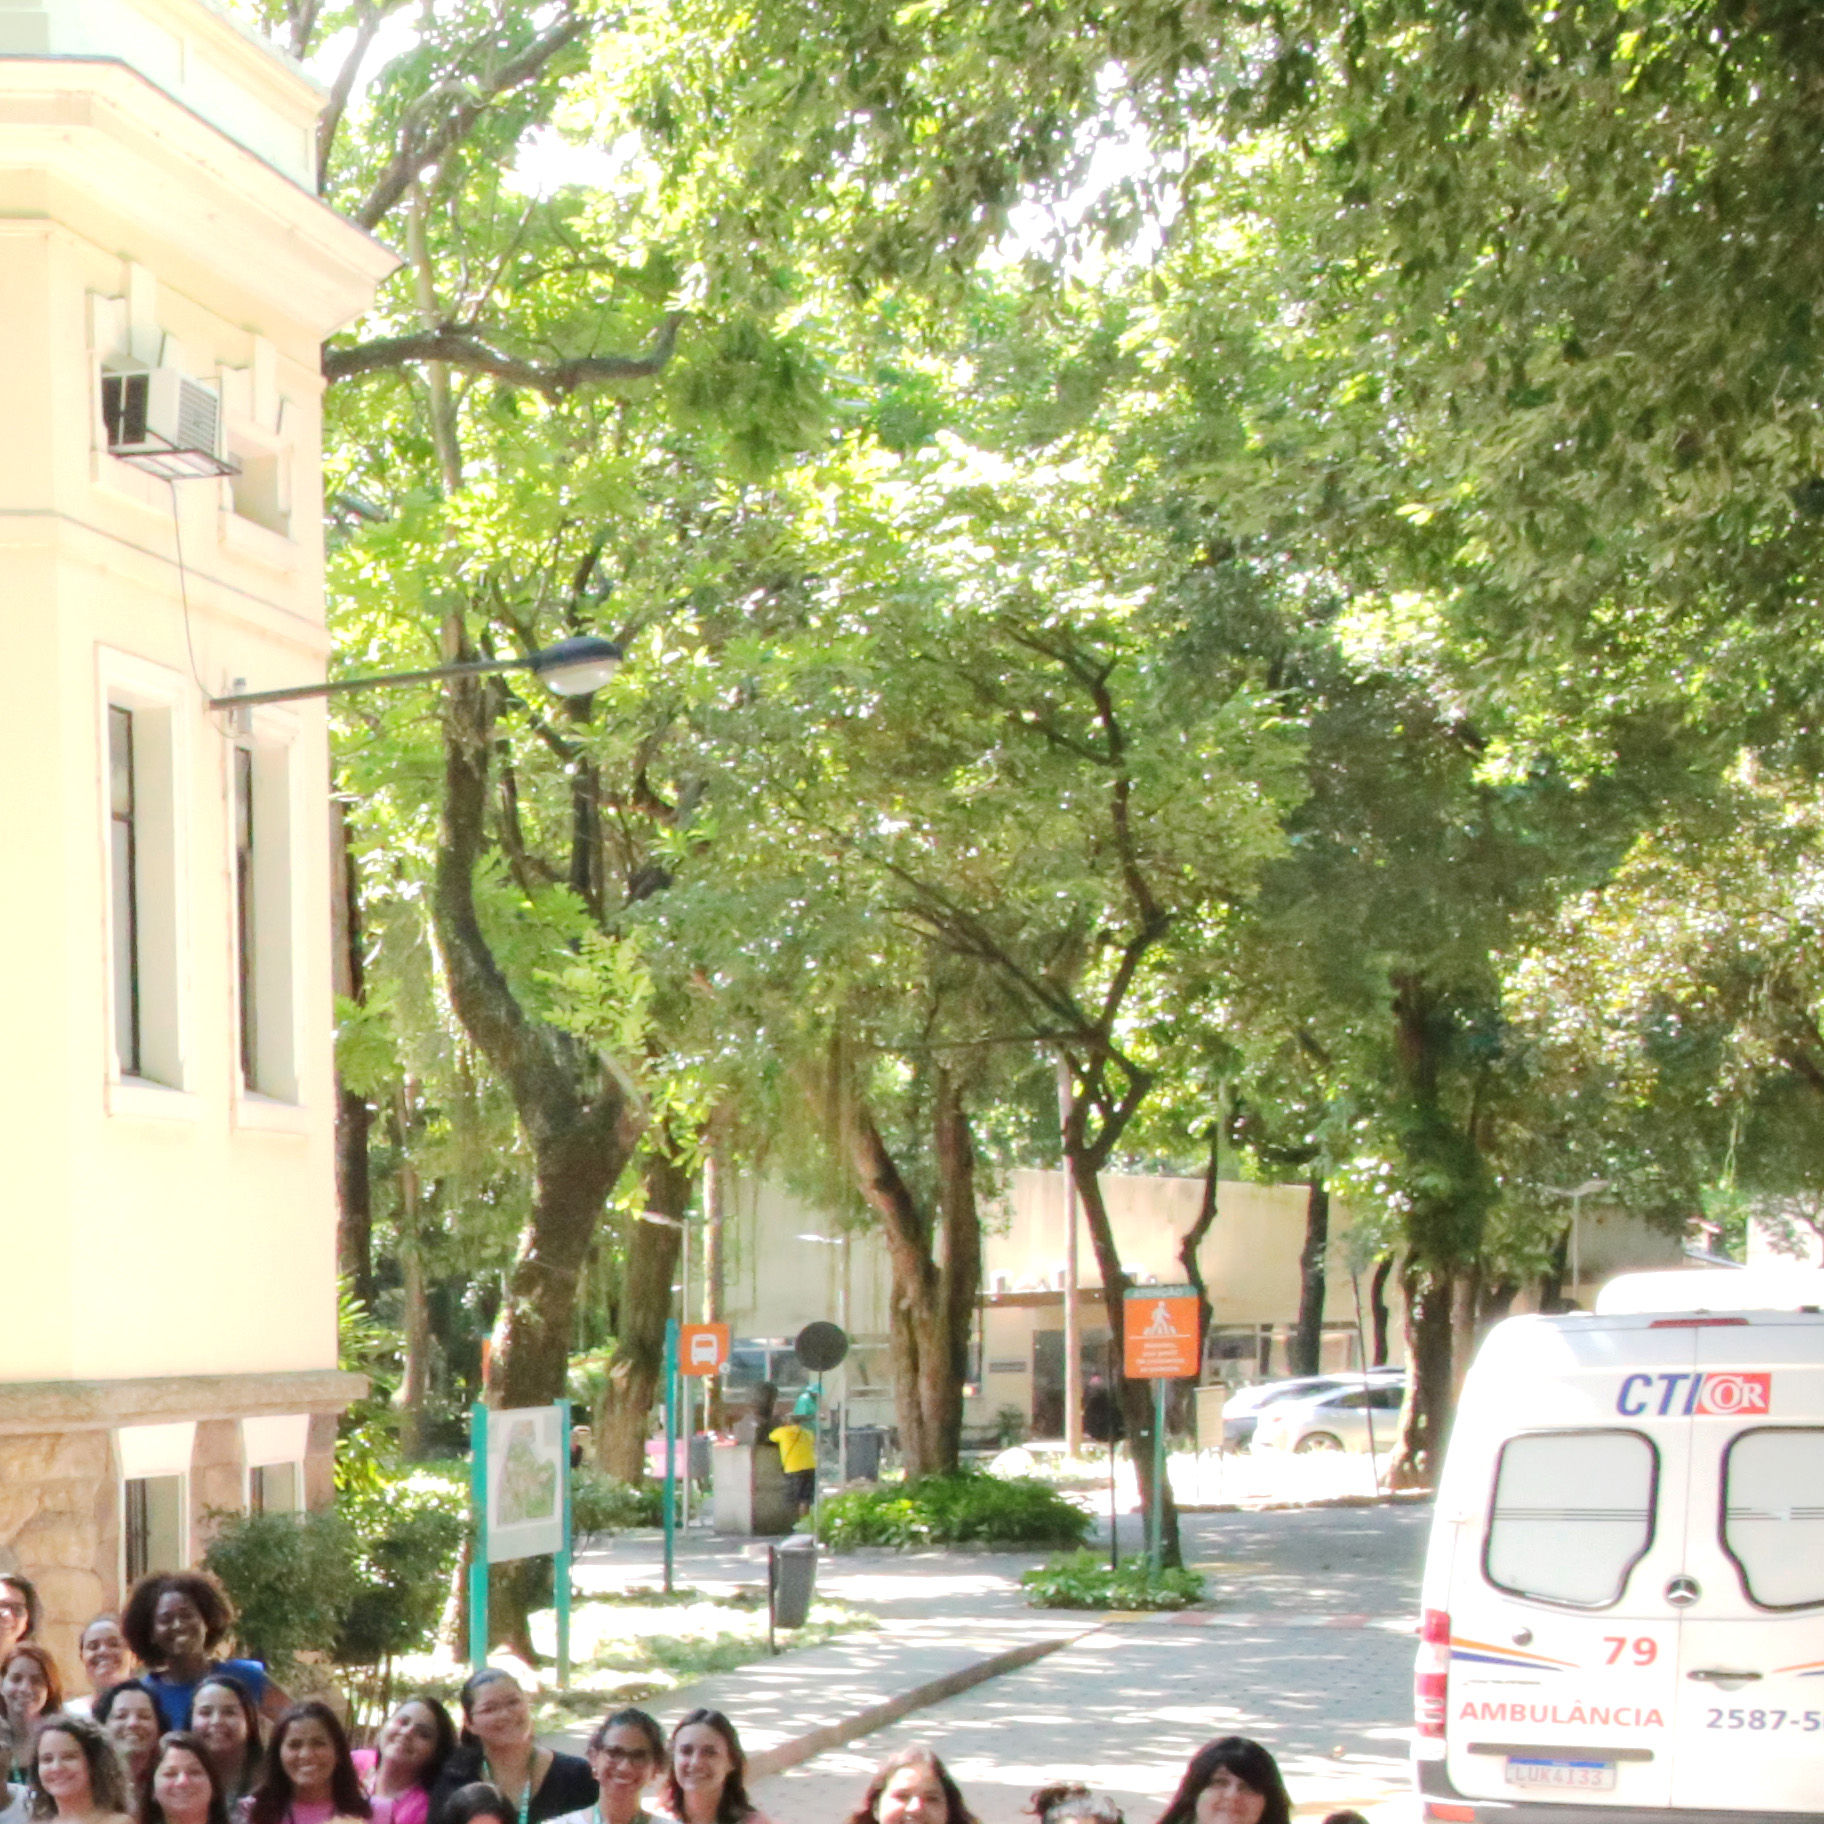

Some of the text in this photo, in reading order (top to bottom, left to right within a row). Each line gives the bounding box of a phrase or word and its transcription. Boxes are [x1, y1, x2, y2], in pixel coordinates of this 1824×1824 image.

[1603, 1636, 1658, 1666] 79
[1458, 1699, 1665, 1728] AMBULÂNCIA
[1706, 1708, 1824, 1732] 2587-5
